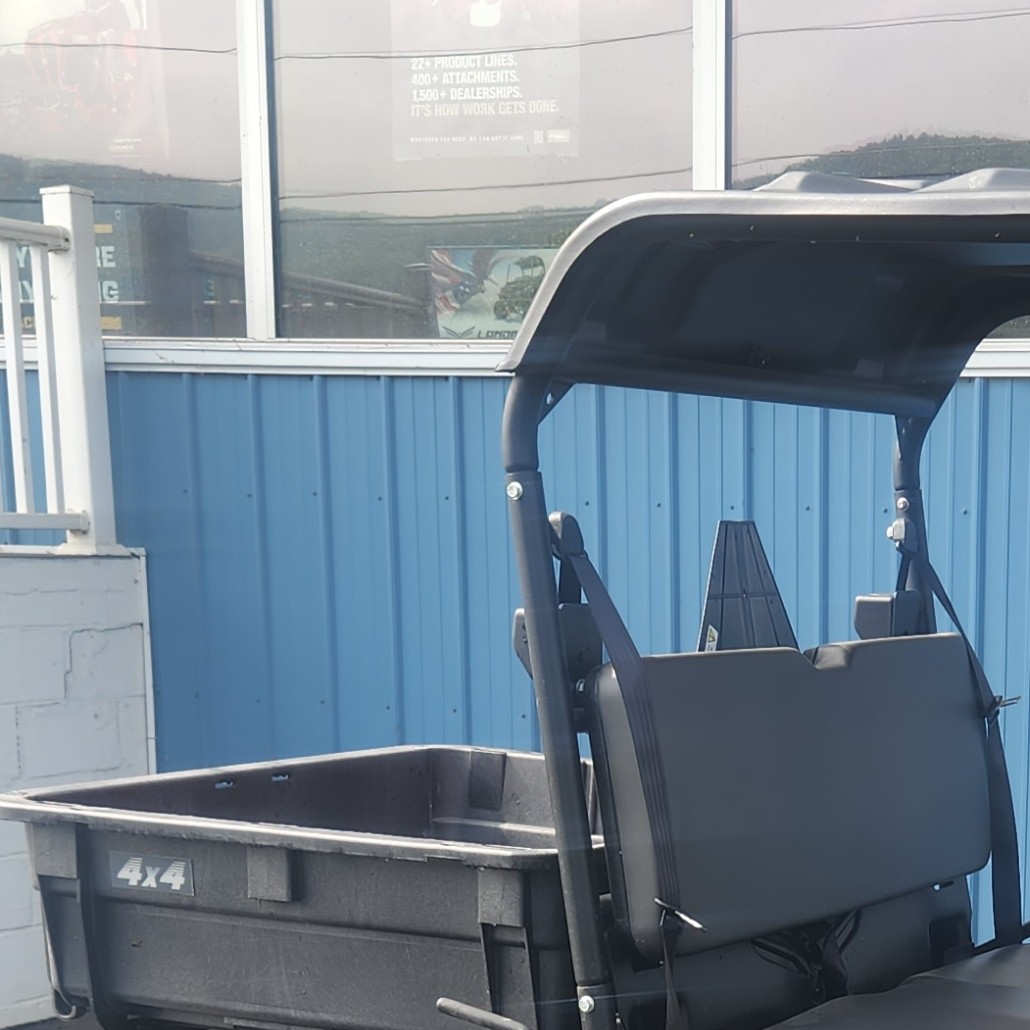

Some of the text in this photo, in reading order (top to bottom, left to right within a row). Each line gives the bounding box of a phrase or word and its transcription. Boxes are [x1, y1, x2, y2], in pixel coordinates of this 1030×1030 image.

[411, 53, 517, 70] 22+ PRODUCT LINES.
[411, 70, 520, 86] 400+ ATTACHMENTS.
[412, 86, 523, 102] 1,500+ DEALERSHIPS.
[411, 100, 559, 117] IT'S HOW WORK GETS DONE.
